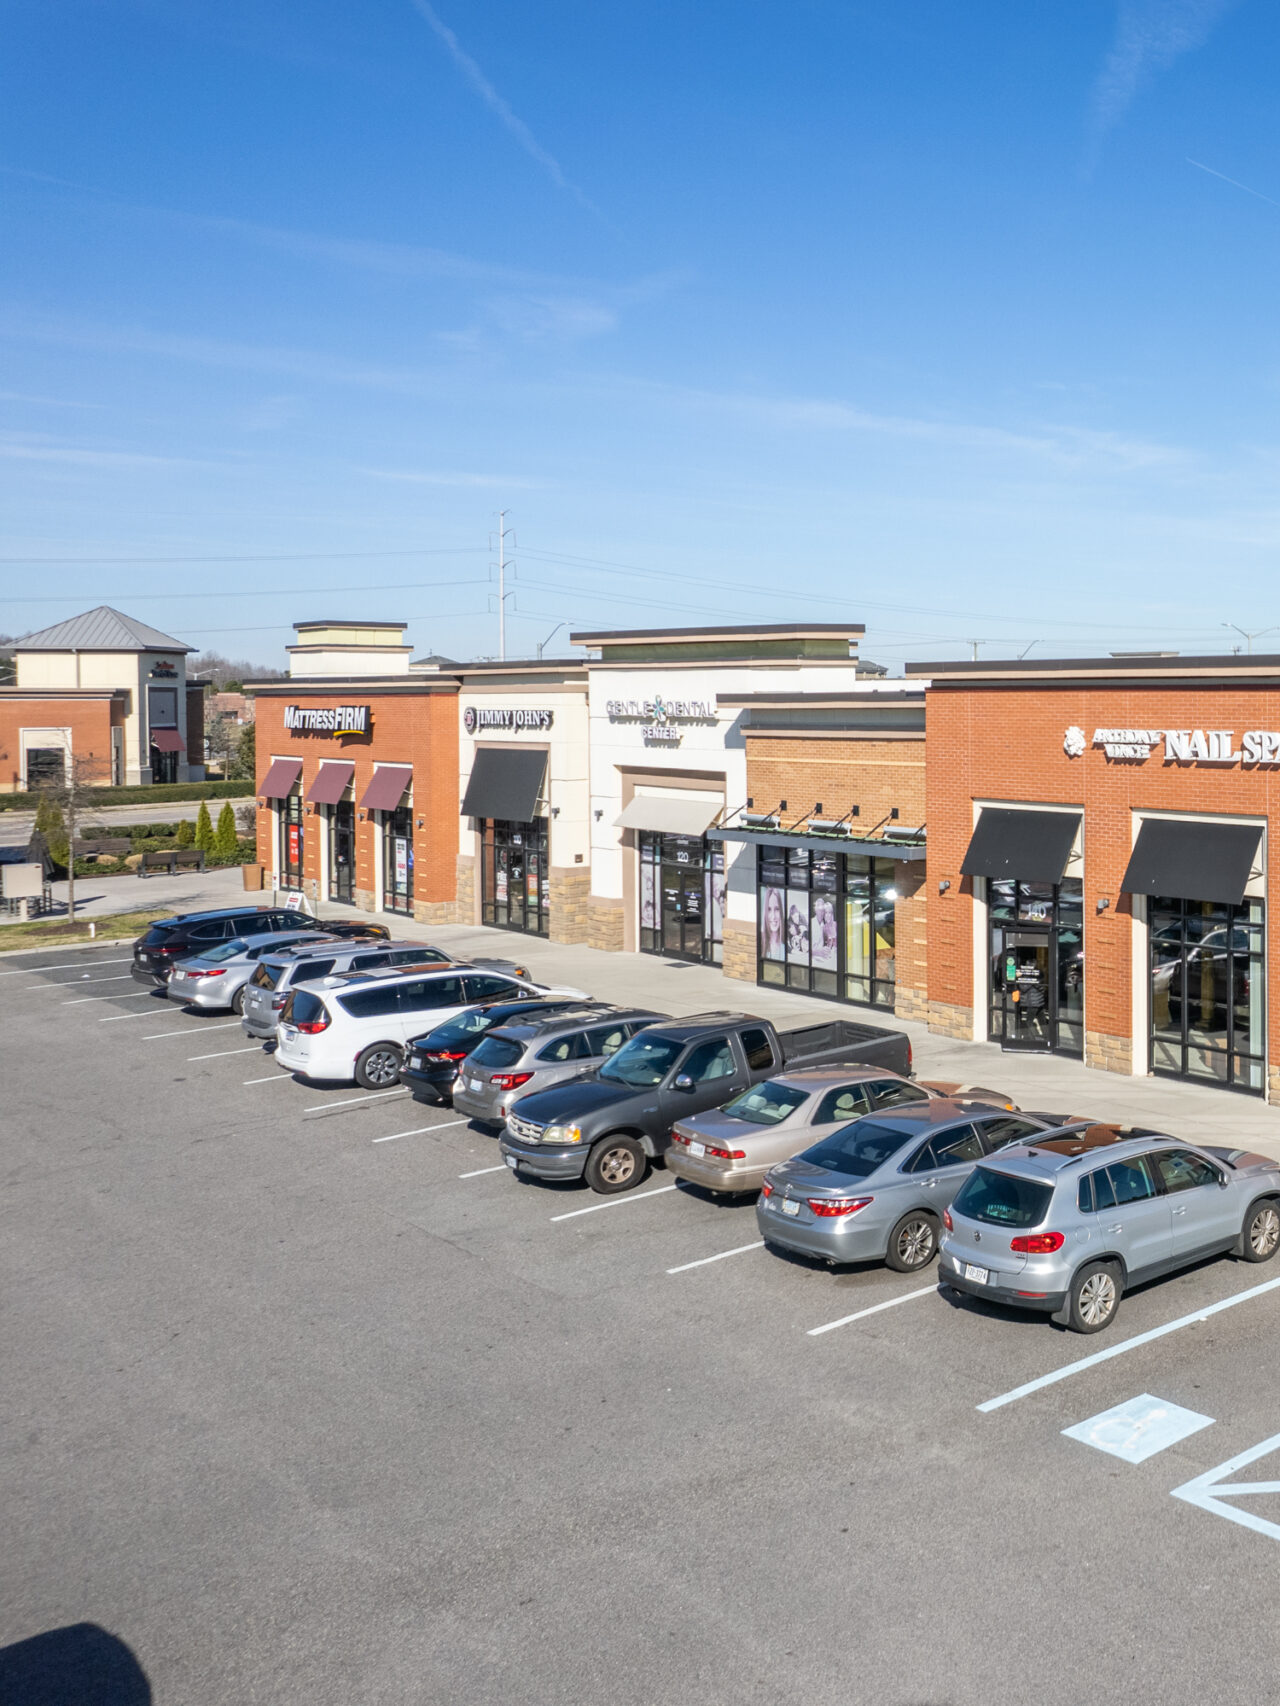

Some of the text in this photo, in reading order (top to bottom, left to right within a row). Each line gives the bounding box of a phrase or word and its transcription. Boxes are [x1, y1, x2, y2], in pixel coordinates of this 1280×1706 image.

[606, 700, 650, 716] GENTLE
[666, 701, 715, 717] DENTAL
[476, 710, 511, 728] JIMMY
[512, 710, 550, 729] JOHN'S
[641, 726, 677, 740] CENTER
[1161, 729, 1242, 760] NAIL
[676, 851, 689, 863] 120
